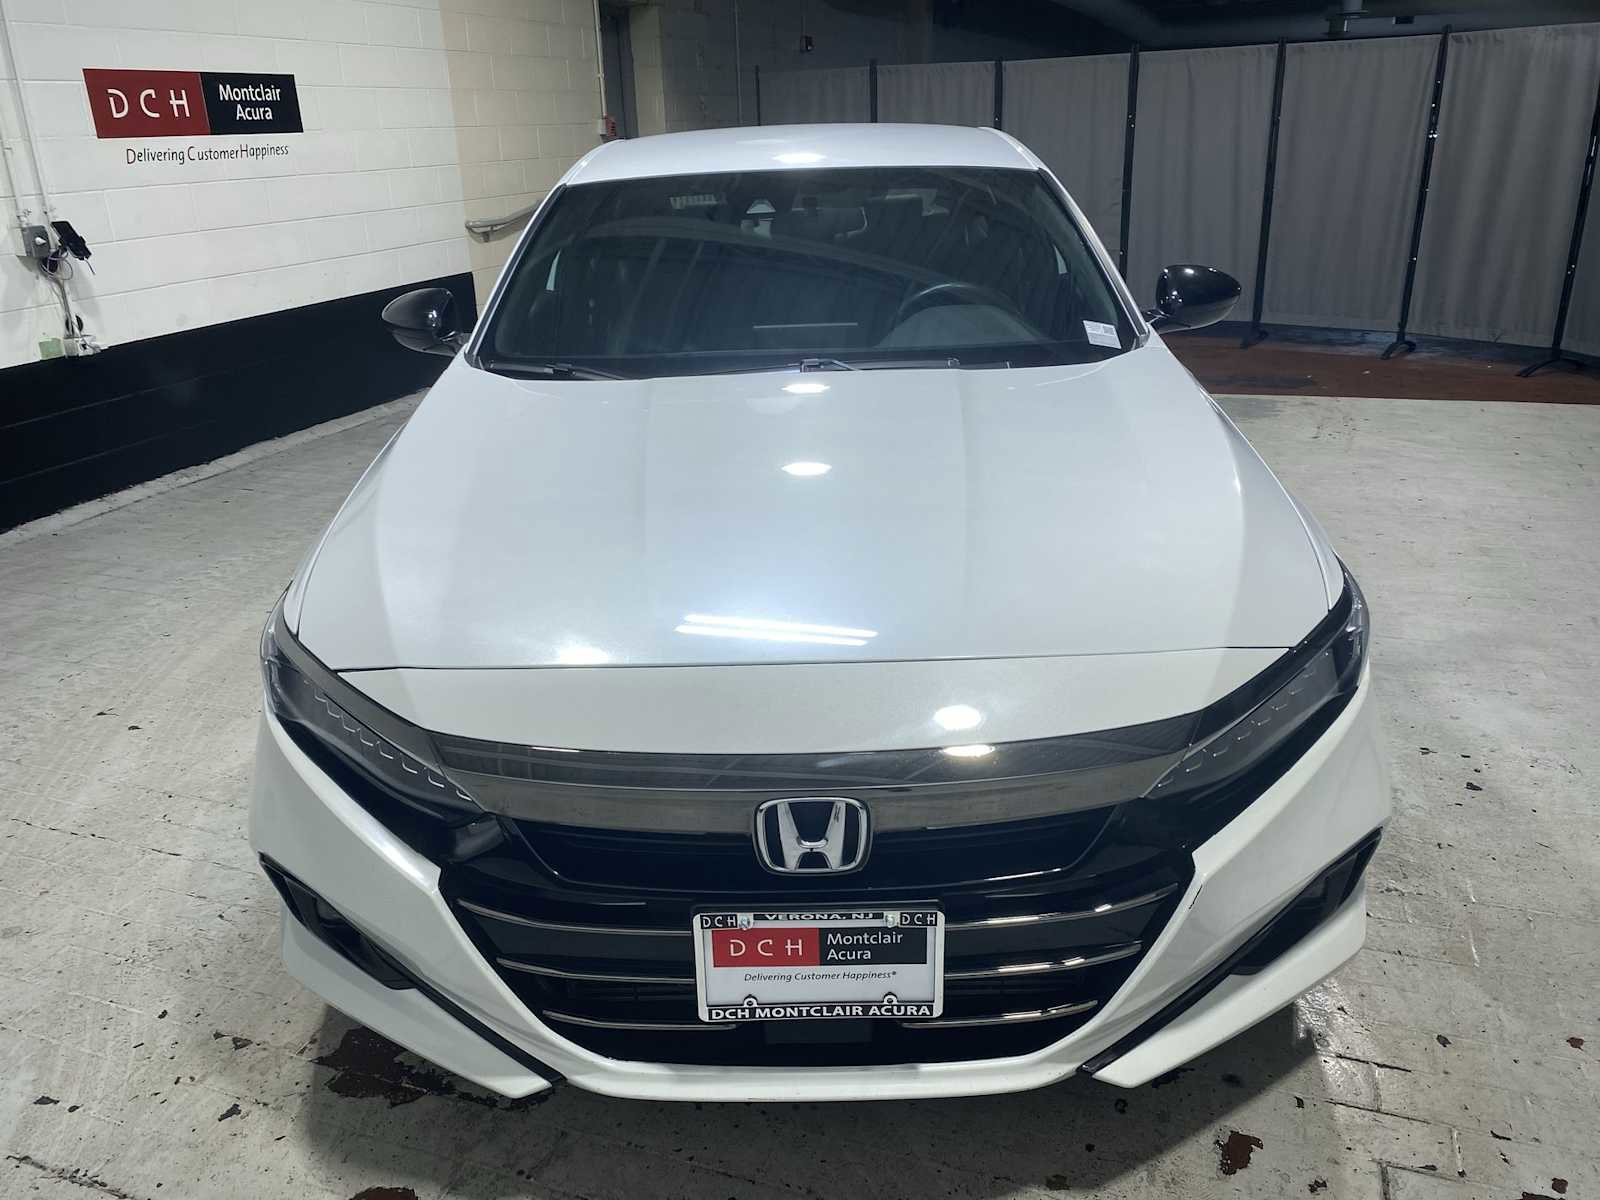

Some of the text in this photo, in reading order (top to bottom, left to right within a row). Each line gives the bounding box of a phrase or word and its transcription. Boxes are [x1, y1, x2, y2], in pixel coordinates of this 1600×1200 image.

[219, 83, 281, 101] Montclair
[107, 88, 190, 118] DCH
[236, 104, 272, 120] Acura
[126, 147, 185, 164] Delivering
[702, 915, 736, 928] DCH
[901, 913, 936, 925] DCH
[826, 931, 903, 945] Montclair
[730, 939, 802, 956] DCH
[826, 947, 872, 961] Acura
[744, 972, 792, 982] Delivering
[794, 971, 840, 981] Customer
[712, 1005, 930, 1019] DCH MONTCLAIR ACURA
